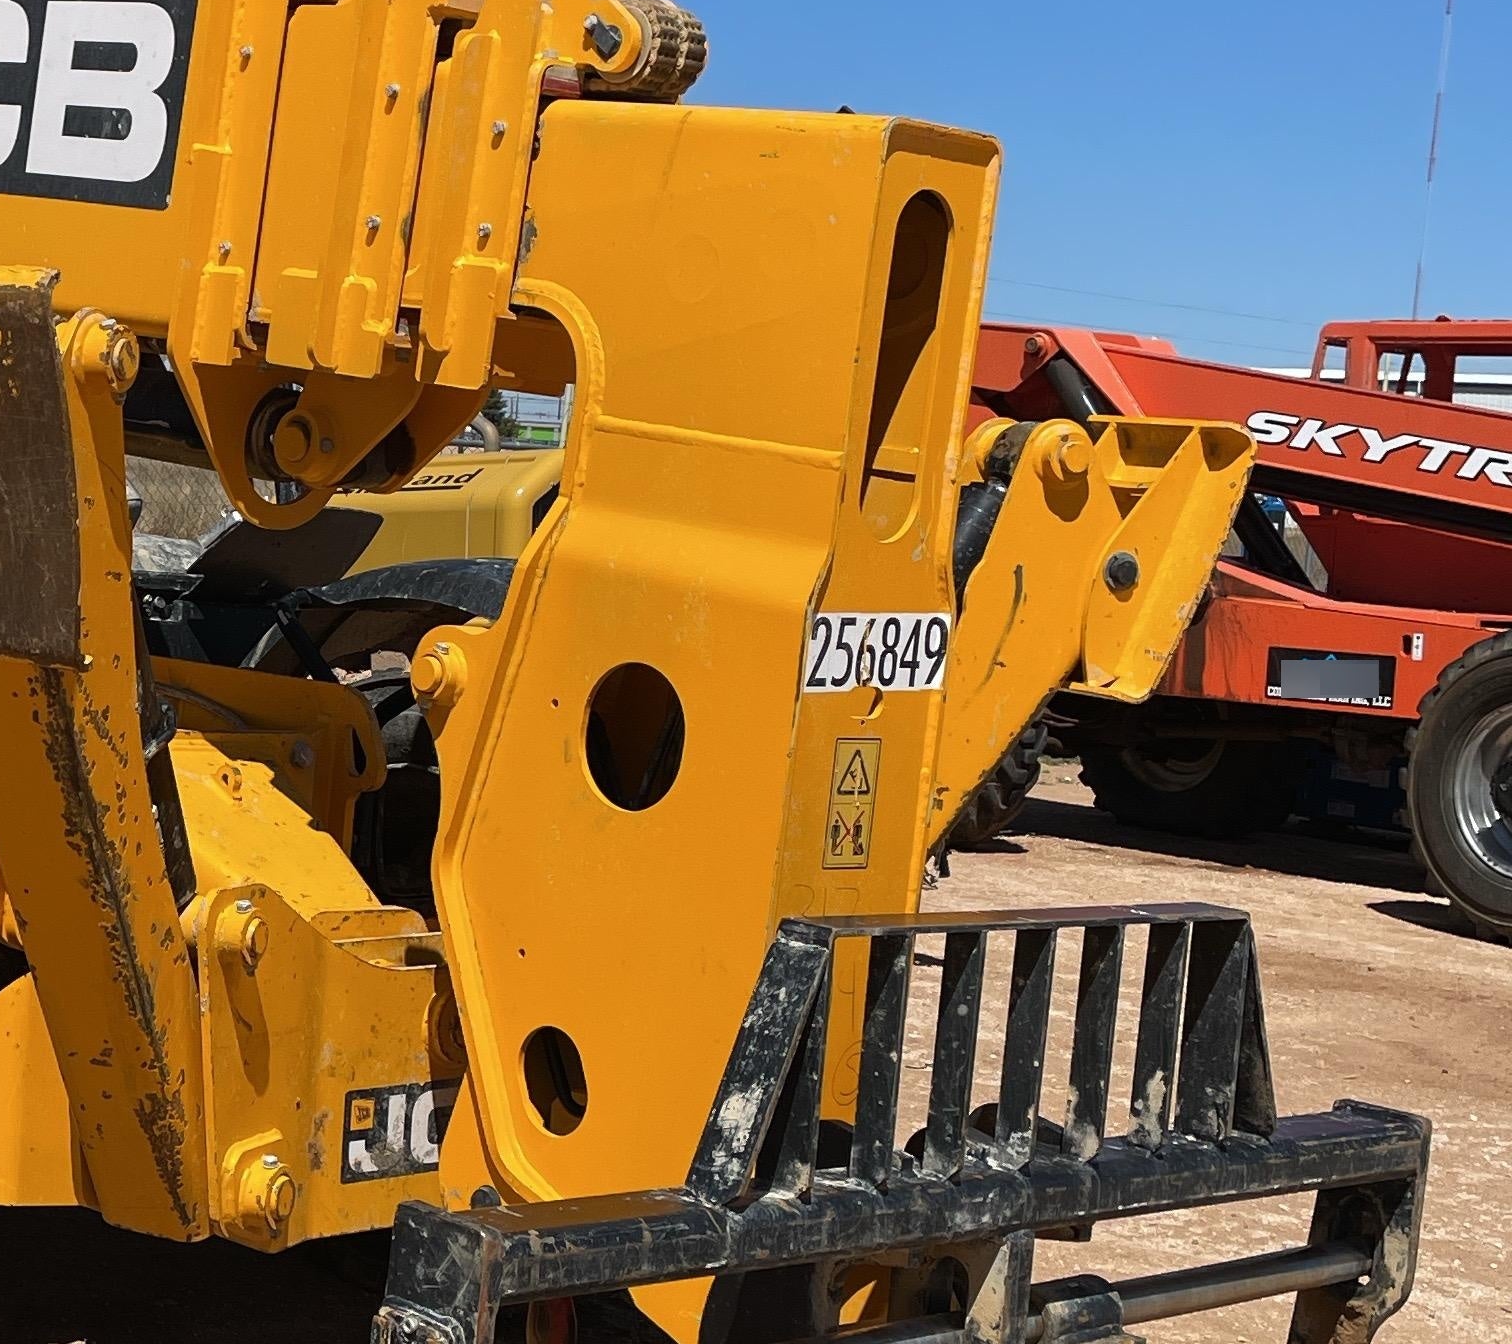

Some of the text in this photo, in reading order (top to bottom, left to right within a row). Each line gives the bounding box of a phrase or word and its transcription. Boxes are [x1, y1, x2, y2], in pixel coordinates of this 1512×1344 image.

[411, 467, 485, 487] and
[1246, 410, 1512, 488] SKYTR
[805, 616, 950, 688] 256849
[348, 1089, 450, 1174] JC
